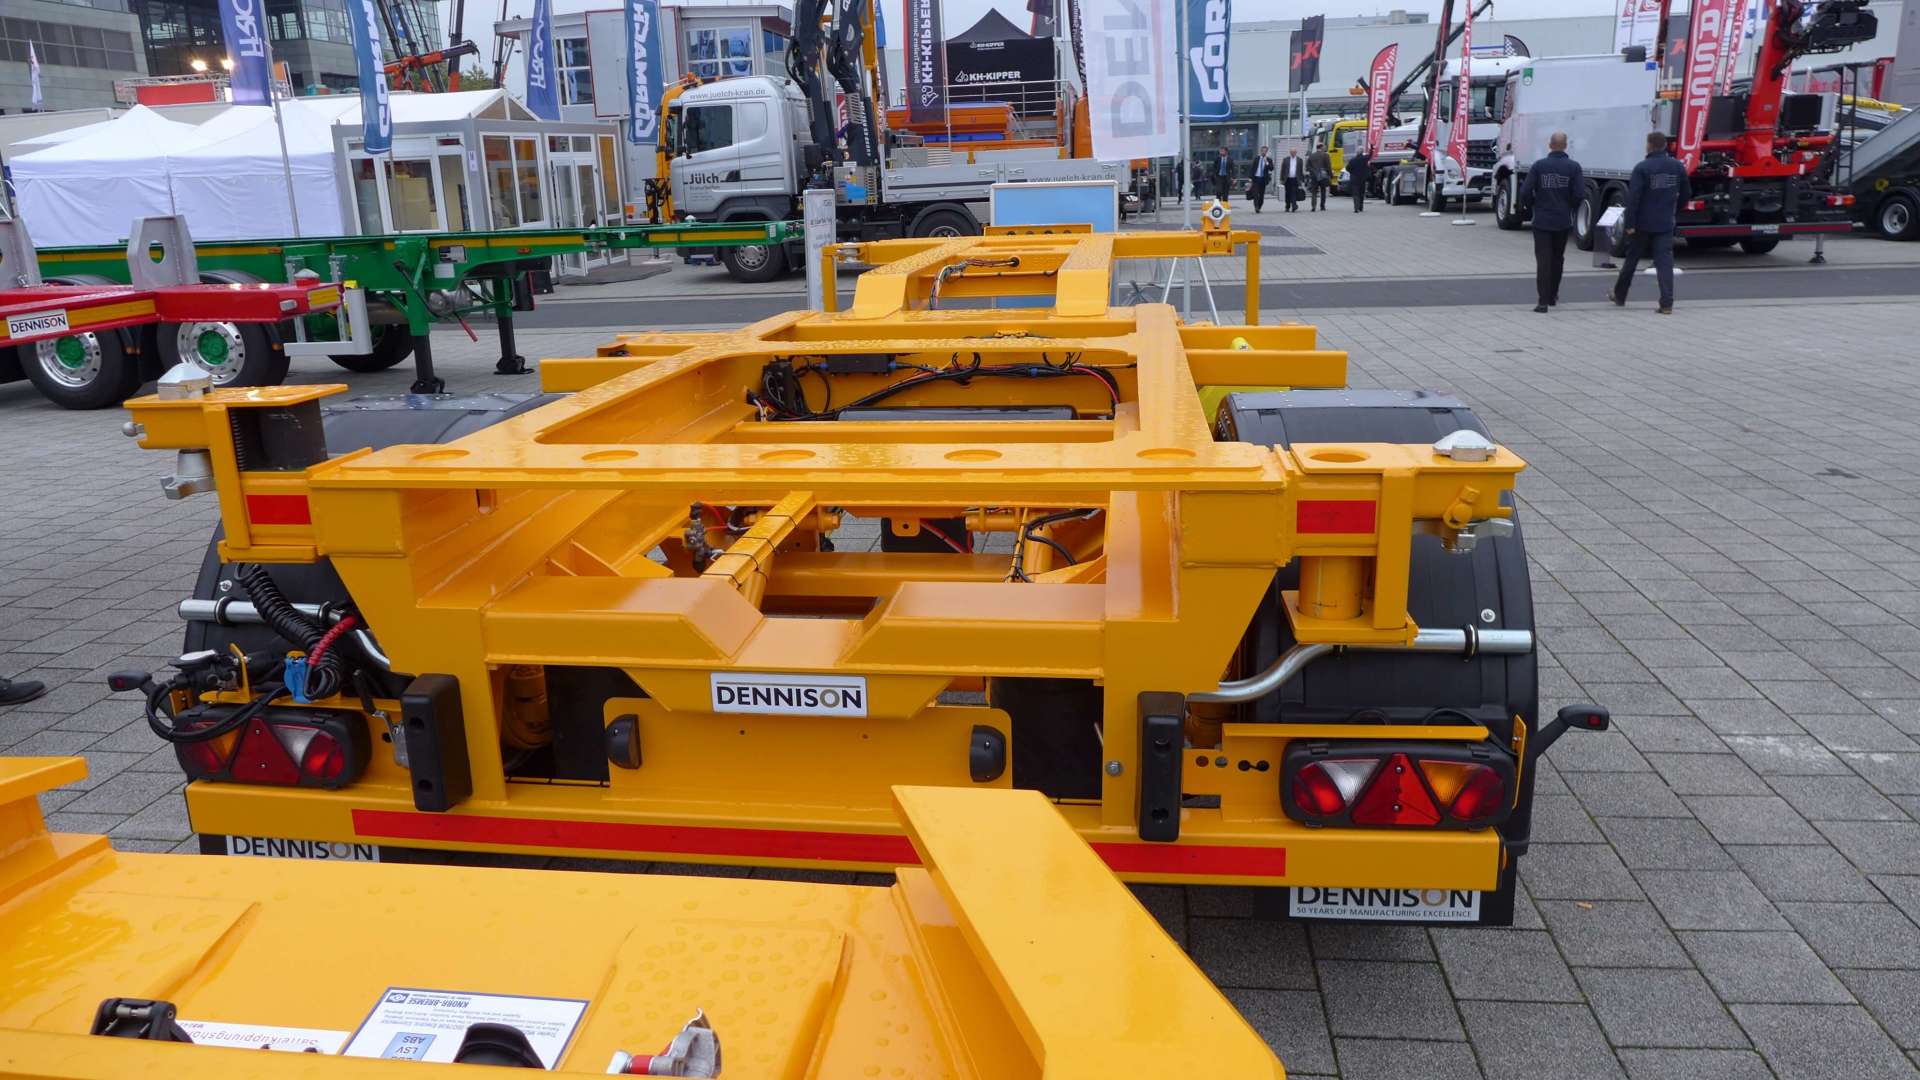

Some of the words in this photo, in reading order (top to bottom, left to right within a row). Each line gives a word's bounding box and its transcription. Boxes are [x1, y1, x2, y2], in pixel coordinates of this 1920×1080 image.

[970, 71, 1020, 80] KH-KIPPER
[690, 88, 765, 99] www.juelch-kran.de
[689, 172, 719, 184] Jülch
[10, 316, 66, 334] DENNISON
[717, 686, 862, 708] DENNISON
[233, 835, 373, 861] DENNISON
[1297, 887, 1473, 908] DENNISON
[1350, 909, 1421, 918] MANUFACTURING
[407, 998, 470, 1009] KNORR-BREMSE
[402, 1036, 426, 1044] ABS
[396, 1046, 418, 1054] LSV
